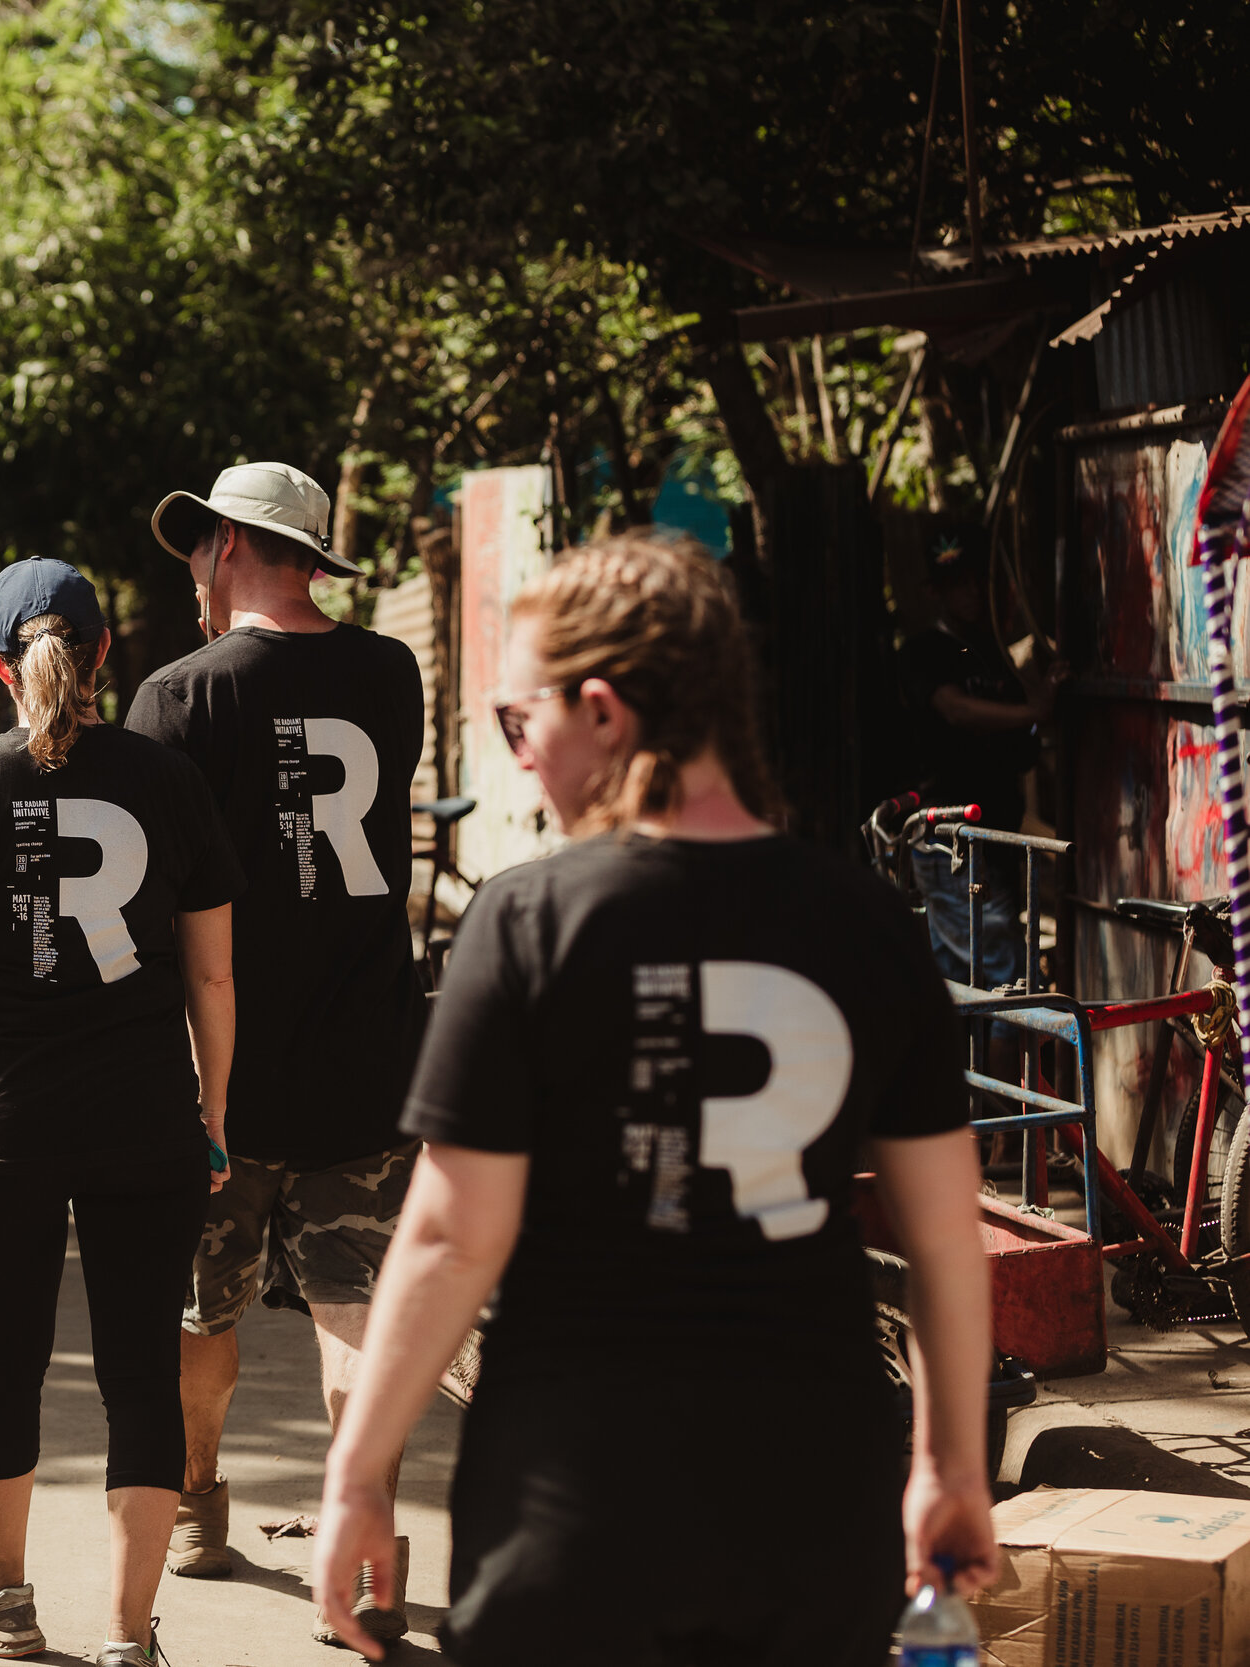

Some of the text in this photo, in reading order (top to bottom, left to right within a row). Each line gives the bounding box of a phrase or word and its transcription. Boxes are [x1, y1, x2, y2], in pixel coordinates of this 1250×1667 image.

[275, 726, 302, 734] INITIATIVE
[304, 718, 389, 896] R
[13, 808, 49, 817] INITIATIVE
[279, 812, 295, 820] MATT
[280, 821, 293, 830] 5:14
[284, 830, 294, 839] -16
[56, 798, 148, 984] R
[12, 895, 31, 903] MATT
[13, 904, 27, 912] 5:14
[699, 960, 854, 1242] R
